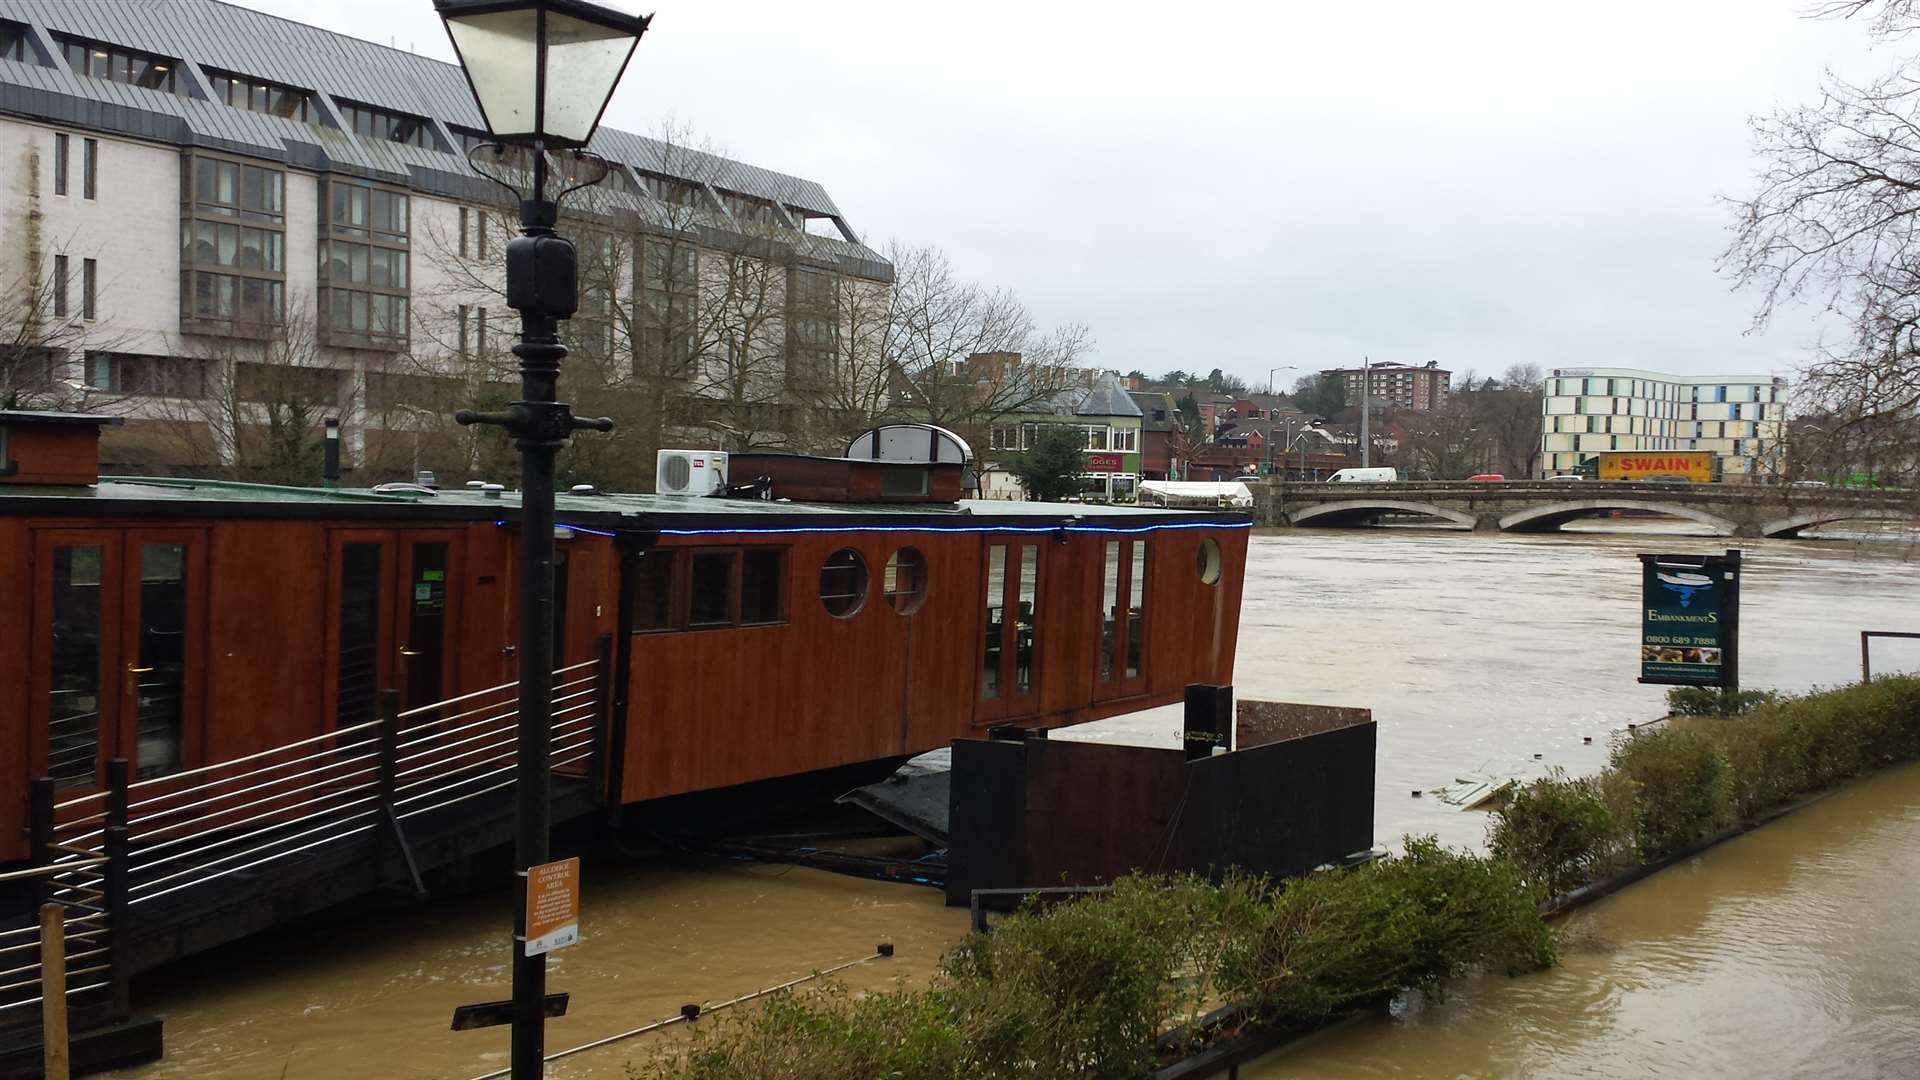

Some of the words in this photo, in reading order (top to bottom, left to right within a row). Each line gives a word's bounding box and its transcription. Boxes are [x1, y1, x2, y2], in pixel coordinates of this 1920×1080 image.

[1621, 458, 1690, 471] SWAIN
[1646, 636, 1670, 644] 0800
[1672, 636, 1690, 644] 689
[538, 871, 570, 883] CONTROL
[546, 880, 563, 889] AREA
